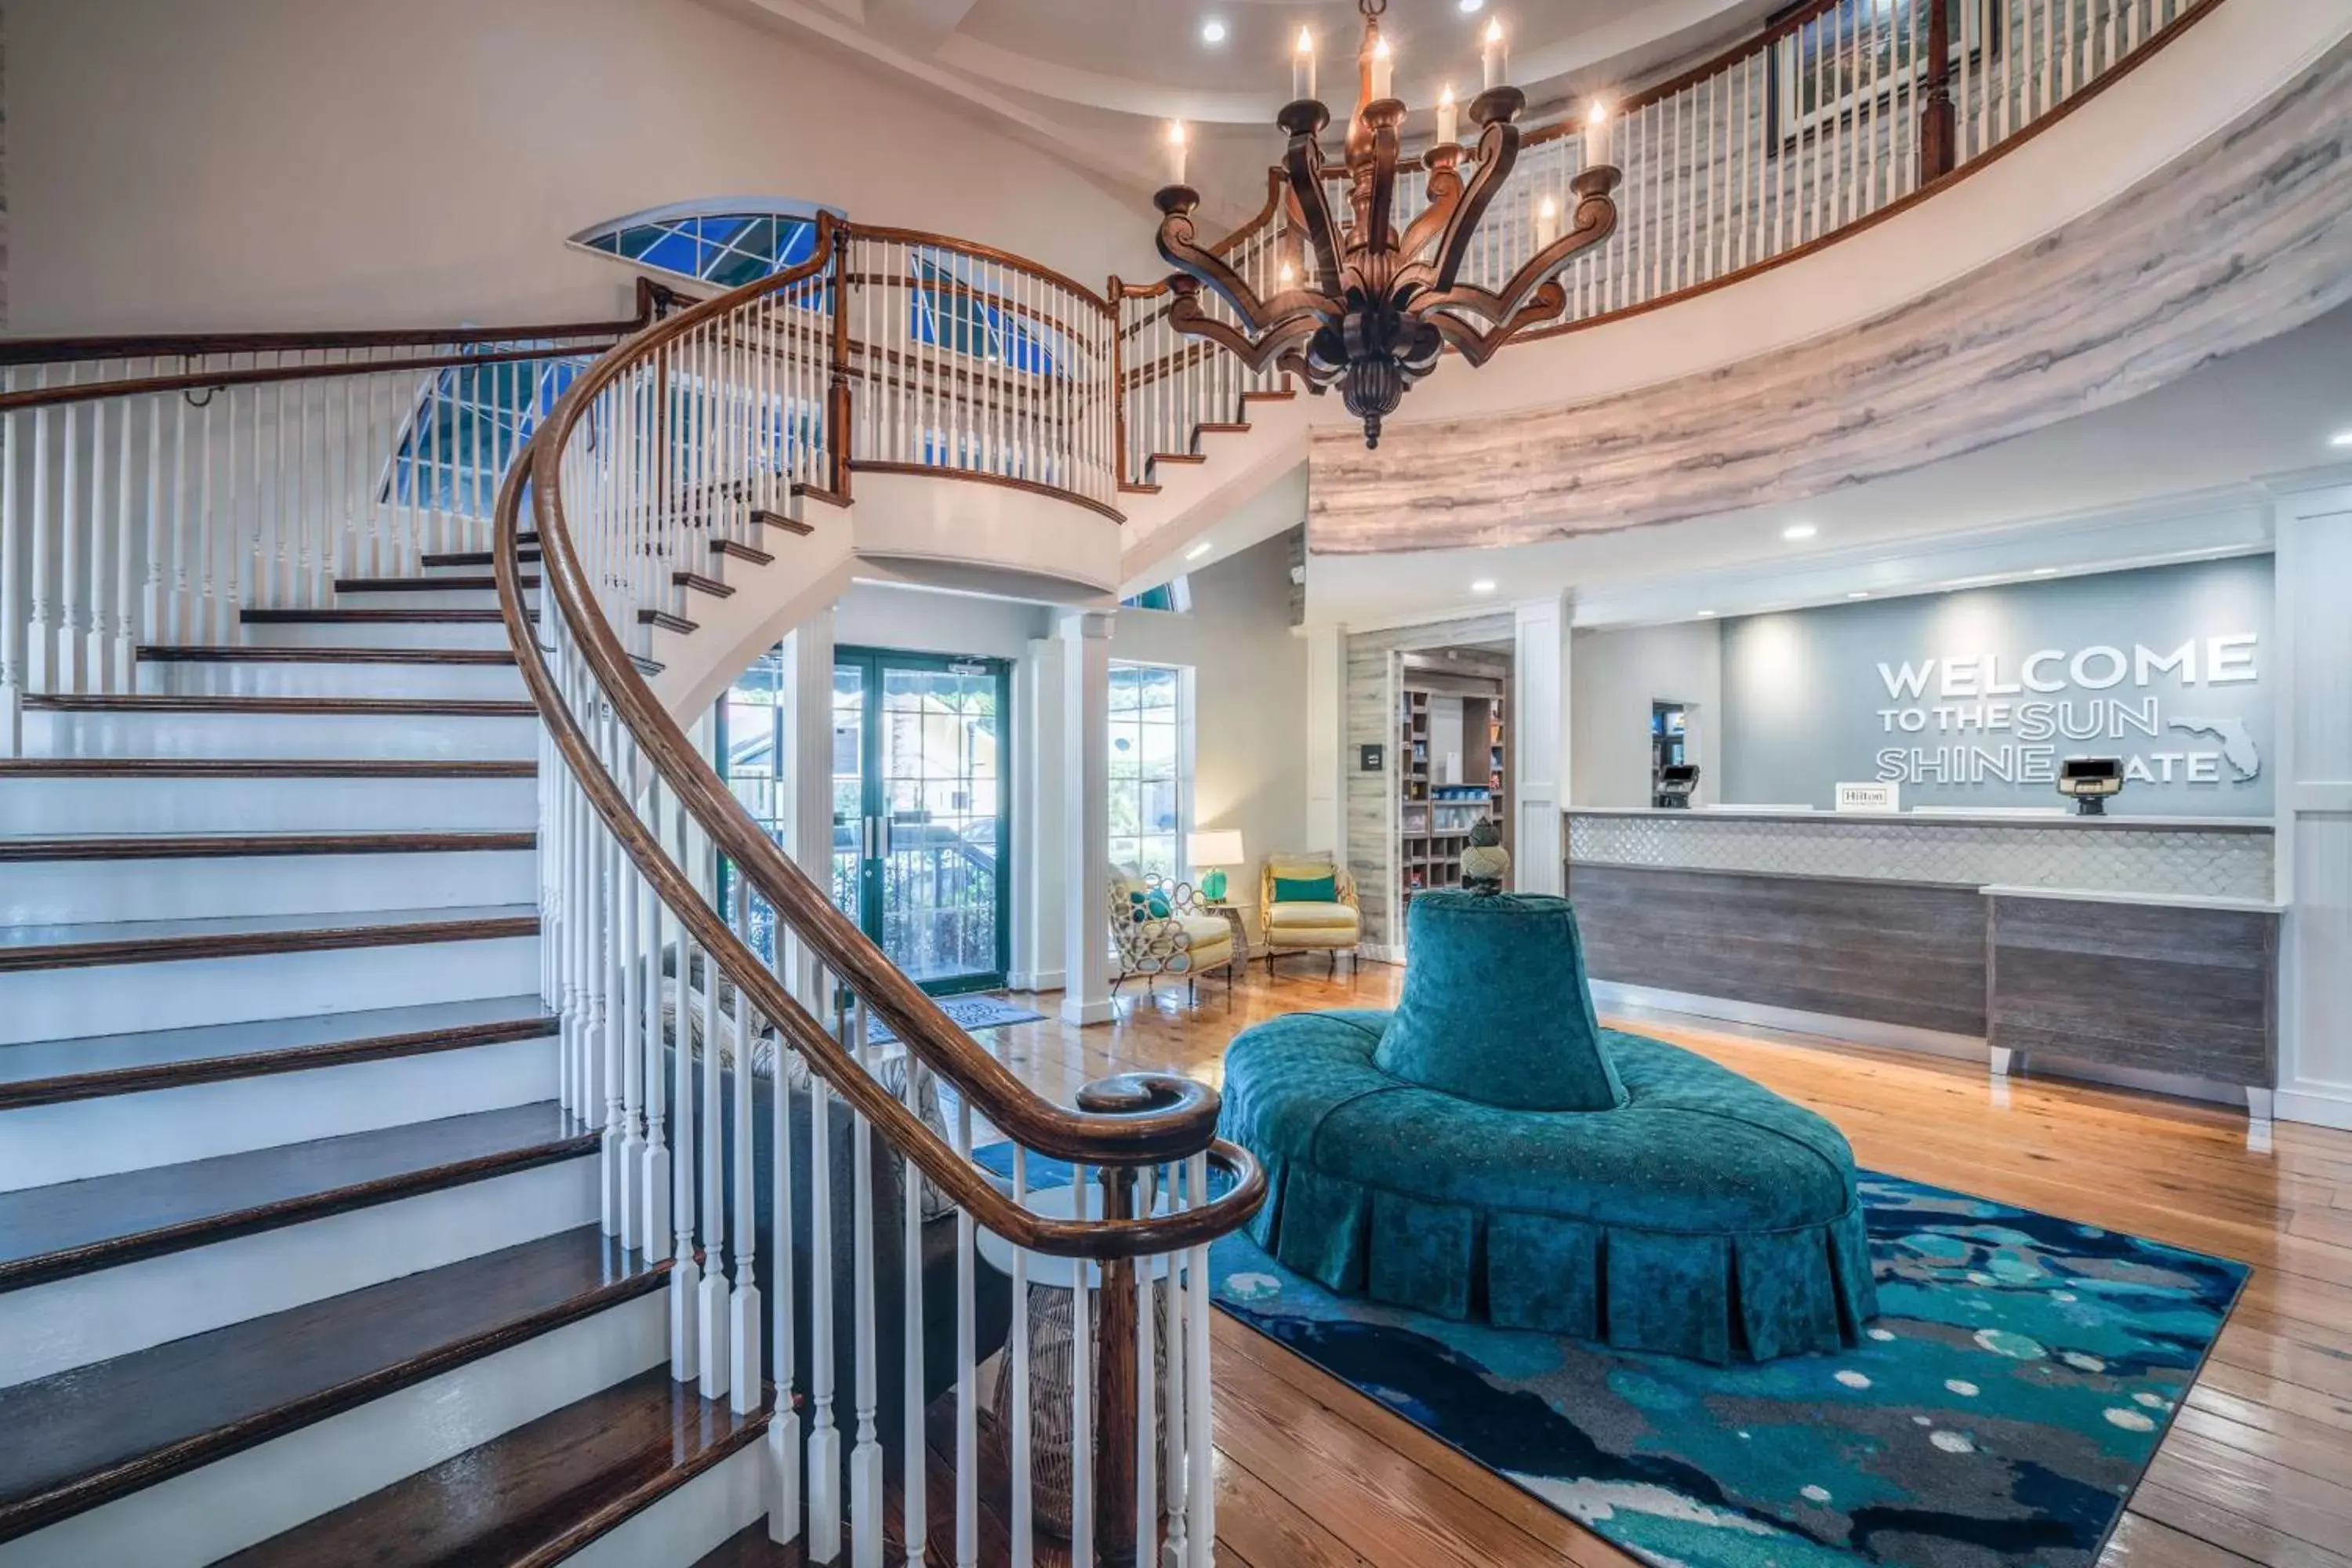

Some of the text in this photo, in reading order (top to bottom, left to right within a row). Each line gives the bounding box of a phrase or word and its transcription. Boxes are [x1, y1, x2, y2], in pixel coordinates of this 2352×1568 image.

[1876, 633, 2258, 700] WELCOME
[1876, 697, 2158, 741] TO THE SUN
[1875, 745, 2220, 783] SHINE ATE
